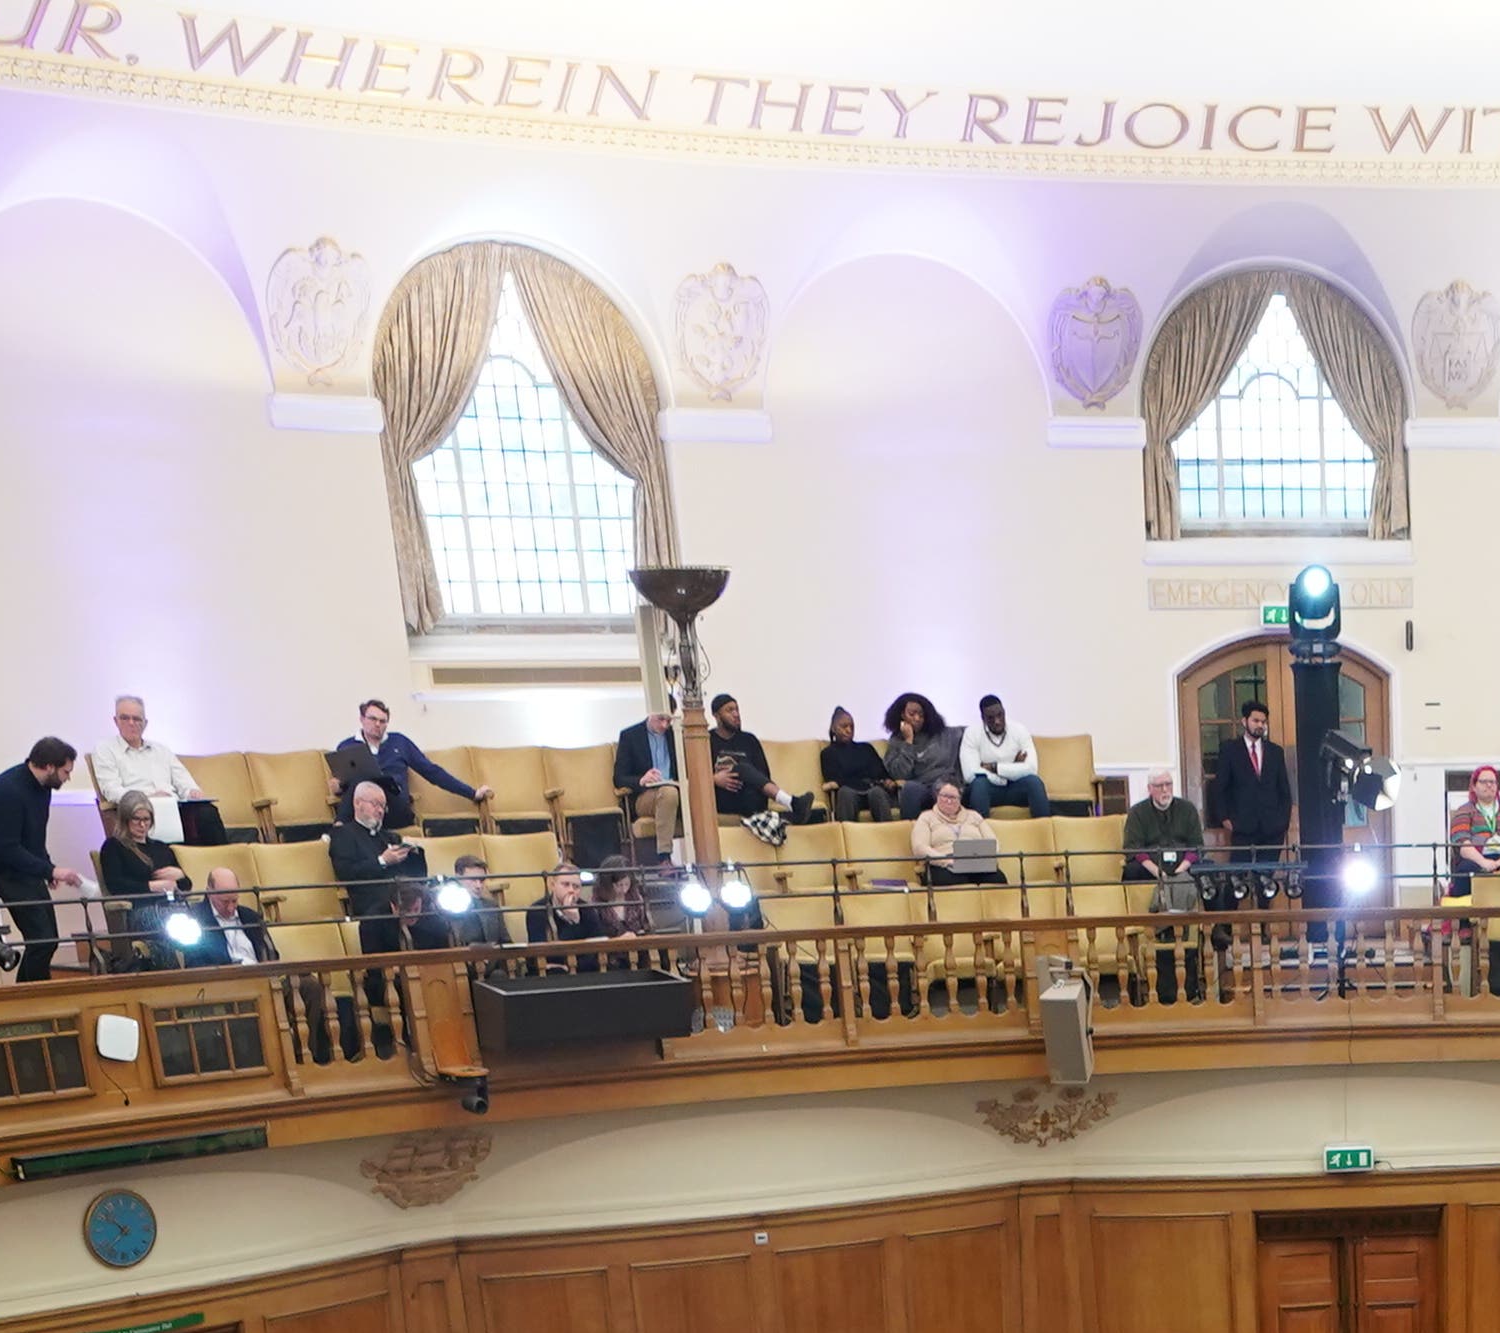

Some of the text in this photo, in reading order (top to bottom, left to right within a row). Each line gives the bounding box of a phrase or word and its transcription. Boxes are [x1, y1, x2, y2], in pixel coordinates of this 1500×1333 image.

[179, 10, 661, 122] WHEREIN
[691, 71, 940, 142] THEY
[960, 90, 1339, 155] REJOICE
[1150, 579, 1410, 608] EMERGENCY ONLY
